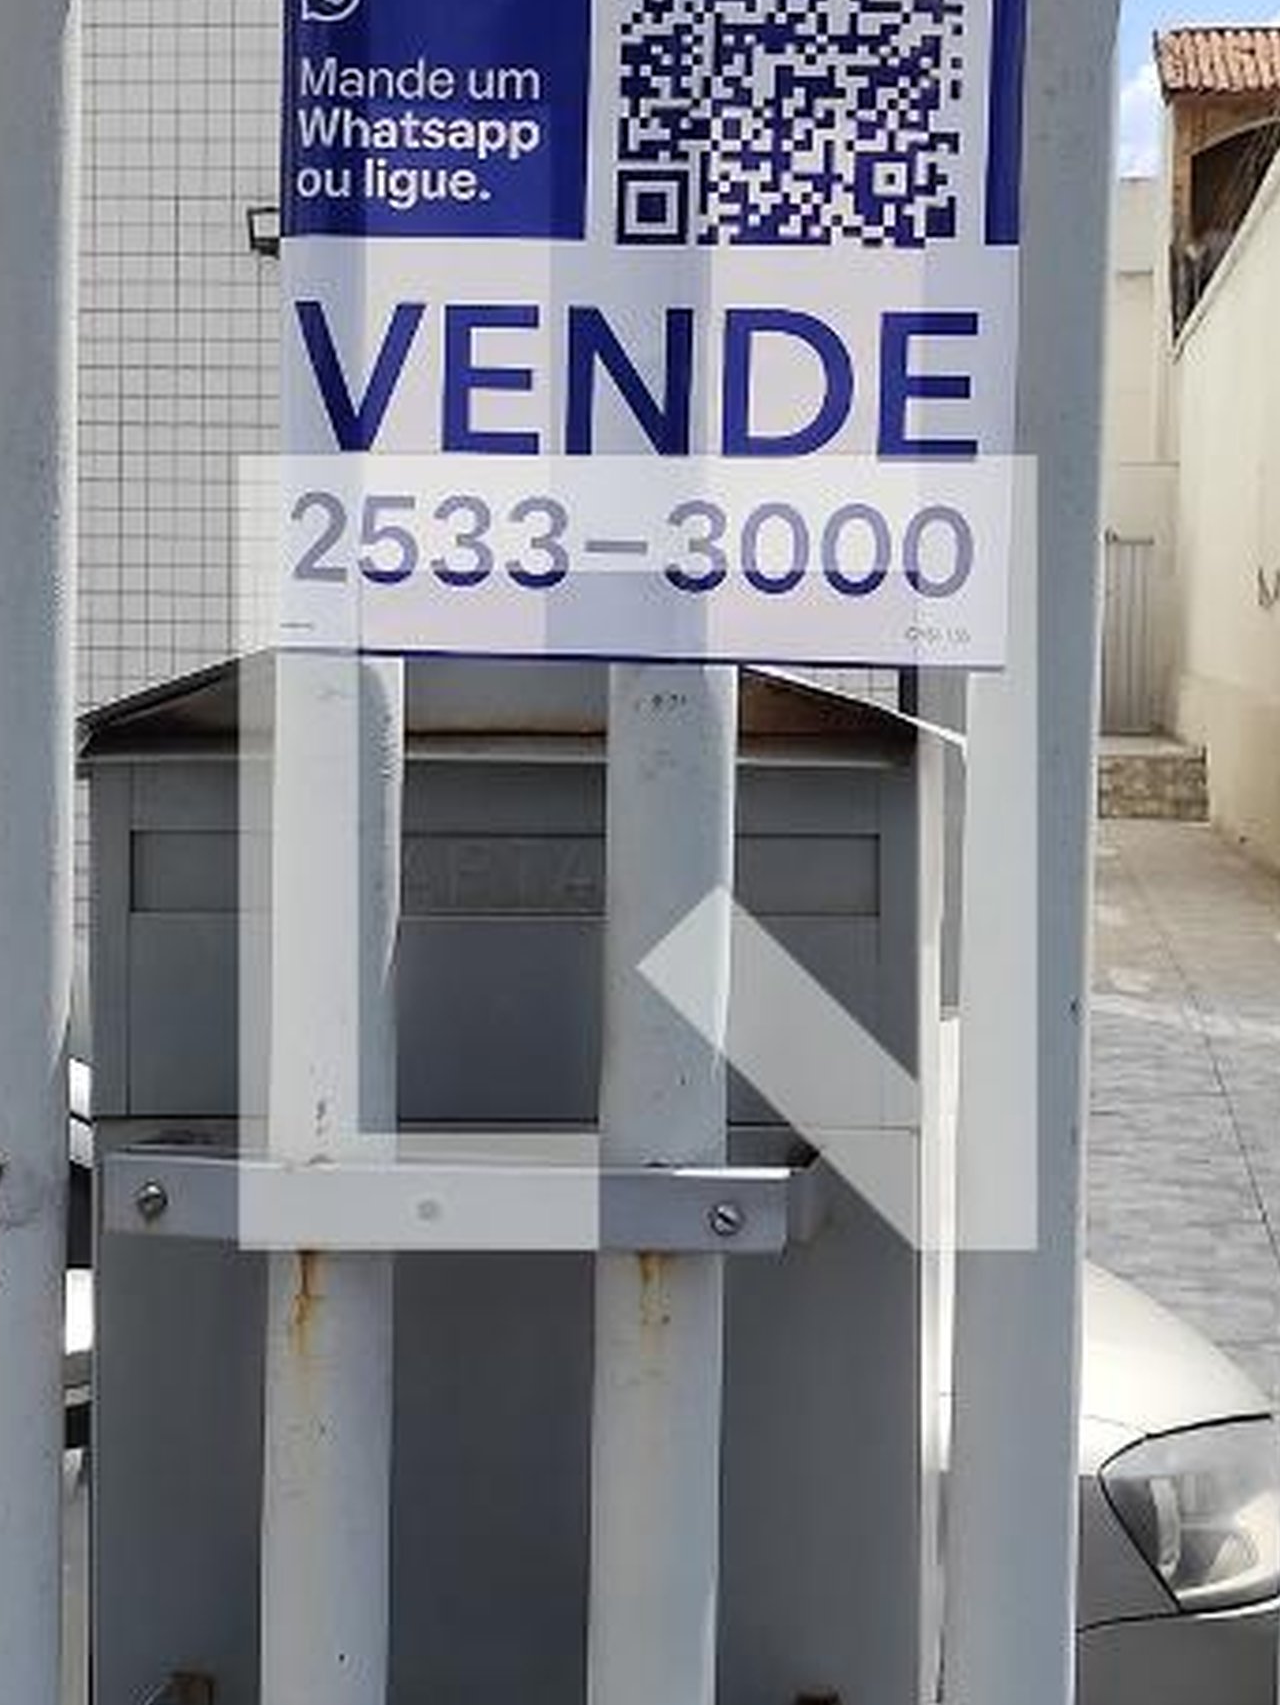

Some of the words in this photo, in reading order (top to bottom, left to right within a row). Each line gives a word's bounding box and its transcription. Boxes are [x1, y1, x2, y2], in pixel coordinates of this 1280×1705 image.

[300, 56, 455, 100] Mande
[468, 67, 541, 100] um
[297, 107, 542, 161] Whatsapp
[296, 166, 352, 198] ou
[365, 157, 492, 210] ligue.
[293, 299, 980, 460] VENDE
[289, 489, 977, 599] 2533-3000
